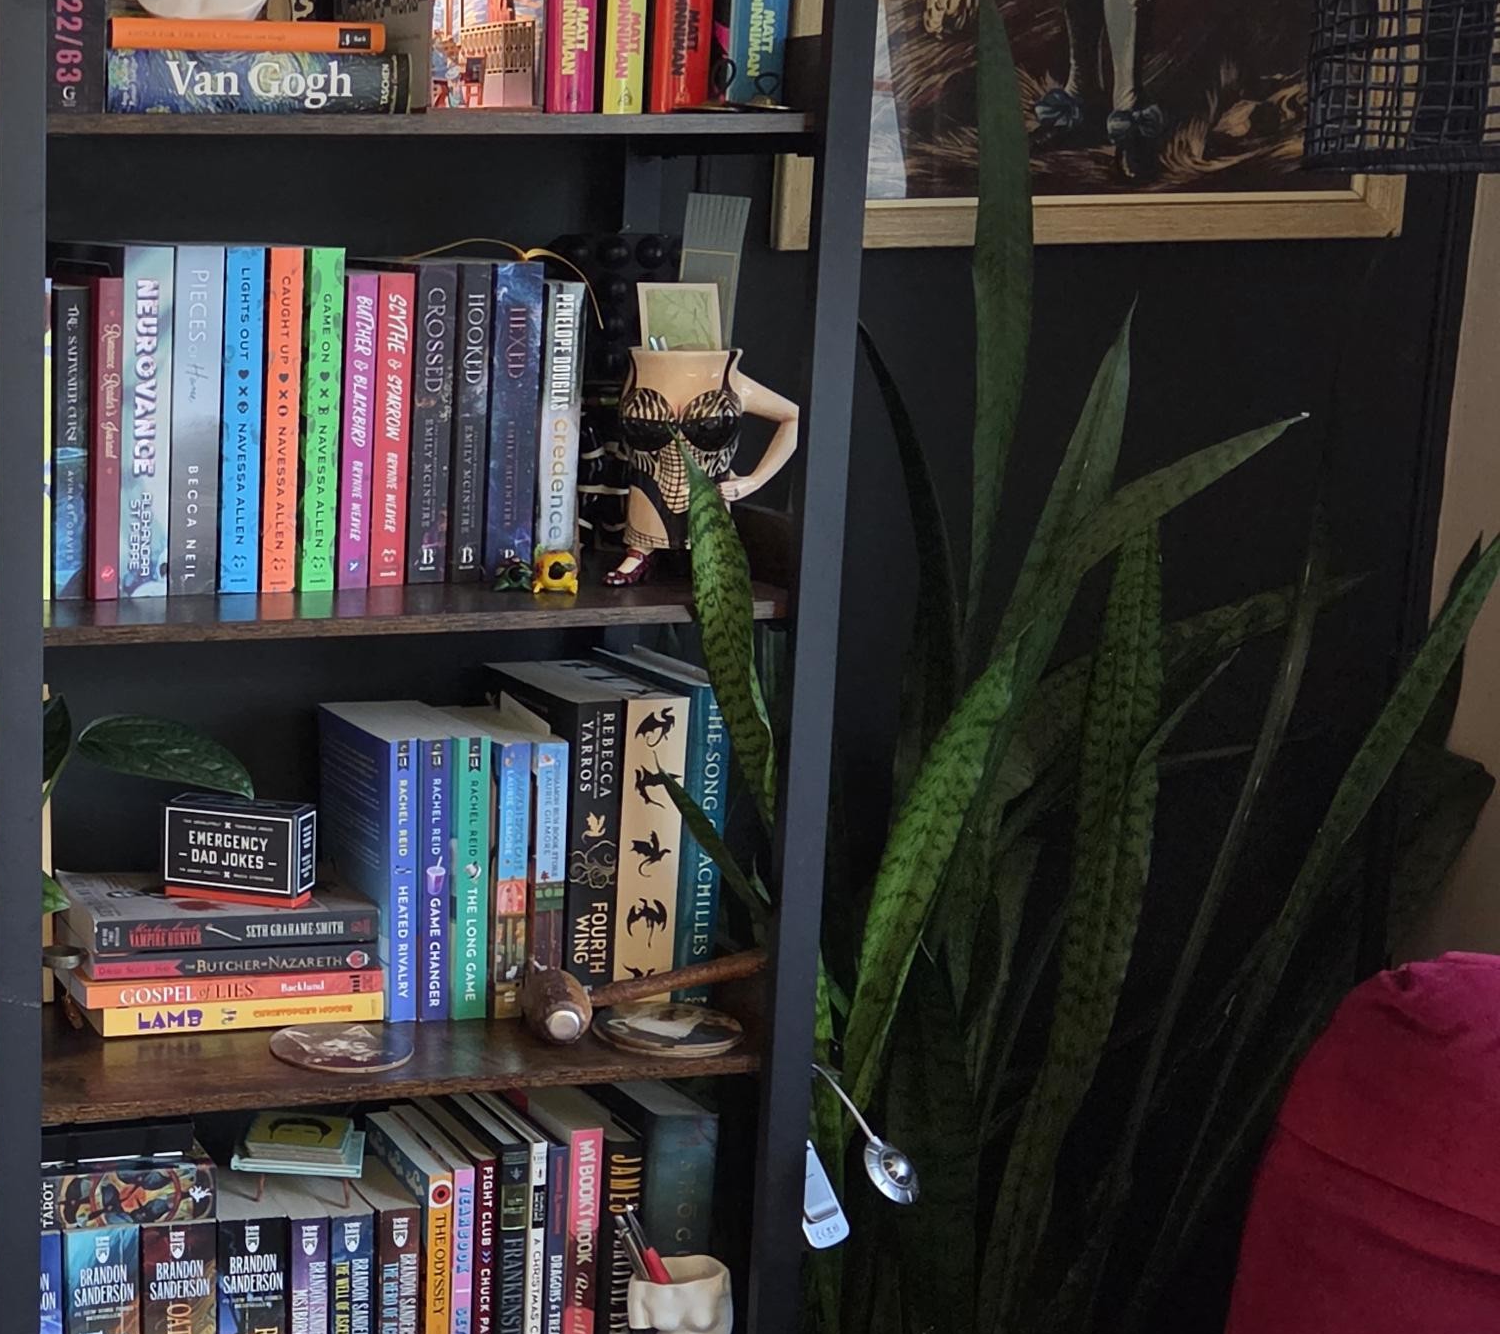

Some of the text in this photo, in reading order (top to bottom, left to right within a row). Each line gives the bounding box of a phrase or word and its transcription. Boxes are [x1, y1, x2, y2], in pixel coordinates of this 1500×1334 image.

[574, 6, 589, 51] MATT
[165, 60, 352, 108] Van Gogh
[380, 63, 389, 105] TASCHEN
[239, 268, 249, 361] LIGHTS OUT
[279, 275, 291, 365] CAUGHT UP
[321, 293, 332, 363] GAME ON
[353, 295, 374, 356] BUTCHER
[387, 293, 408, 354] SCYTHE
[425, 287, 447, 393] CROSSED
[133, 279, 159, 477] NEUROVANCE
[550, 293, 574, 411] PENELOPE DOUGLAS
[350, 375, 369, 448] BLACKBIRD
[384, 375, 403, 441] SPARROW
[235, 423, 247, 545] NAVESSA ALLEN
[549, 418, 569, 540] credence
[184, 465, 199, 579] BECCA NEIL
[580, 720, 594, 793] YARROS
[600, 712, 616, 798] REBECCA
[188, 830, 269, 852] EMERGENCY
[191, 848, 264, 870] DAD JOKES
[397, 779, 409, 998] RACHEL REID HEATED RIVALRY
[196, 954, 342, 973] BUTCHER NAZARETH
[246, 921, 344, 938] SETH GRAHAME-SMITH
[428, 898, 441, 1008] GAME CHANGER
[464, 887, 477, 1002] THE LONG GAME
[574, 914, 591, 965] WING
[590, 901, 608, 975] FOURTH
[120, 984, 254, 1005] GOSPEL of LIES
[138, 1008, 203, 1030] LAMB
[43, 1182, 54, 1227] TAROT
[481, 1166, 494, 1247] FIGHT CLUB
[74, 1283, 134, 1307] SANDERSON
[79, 1264, 127, 1286] BRANDON
